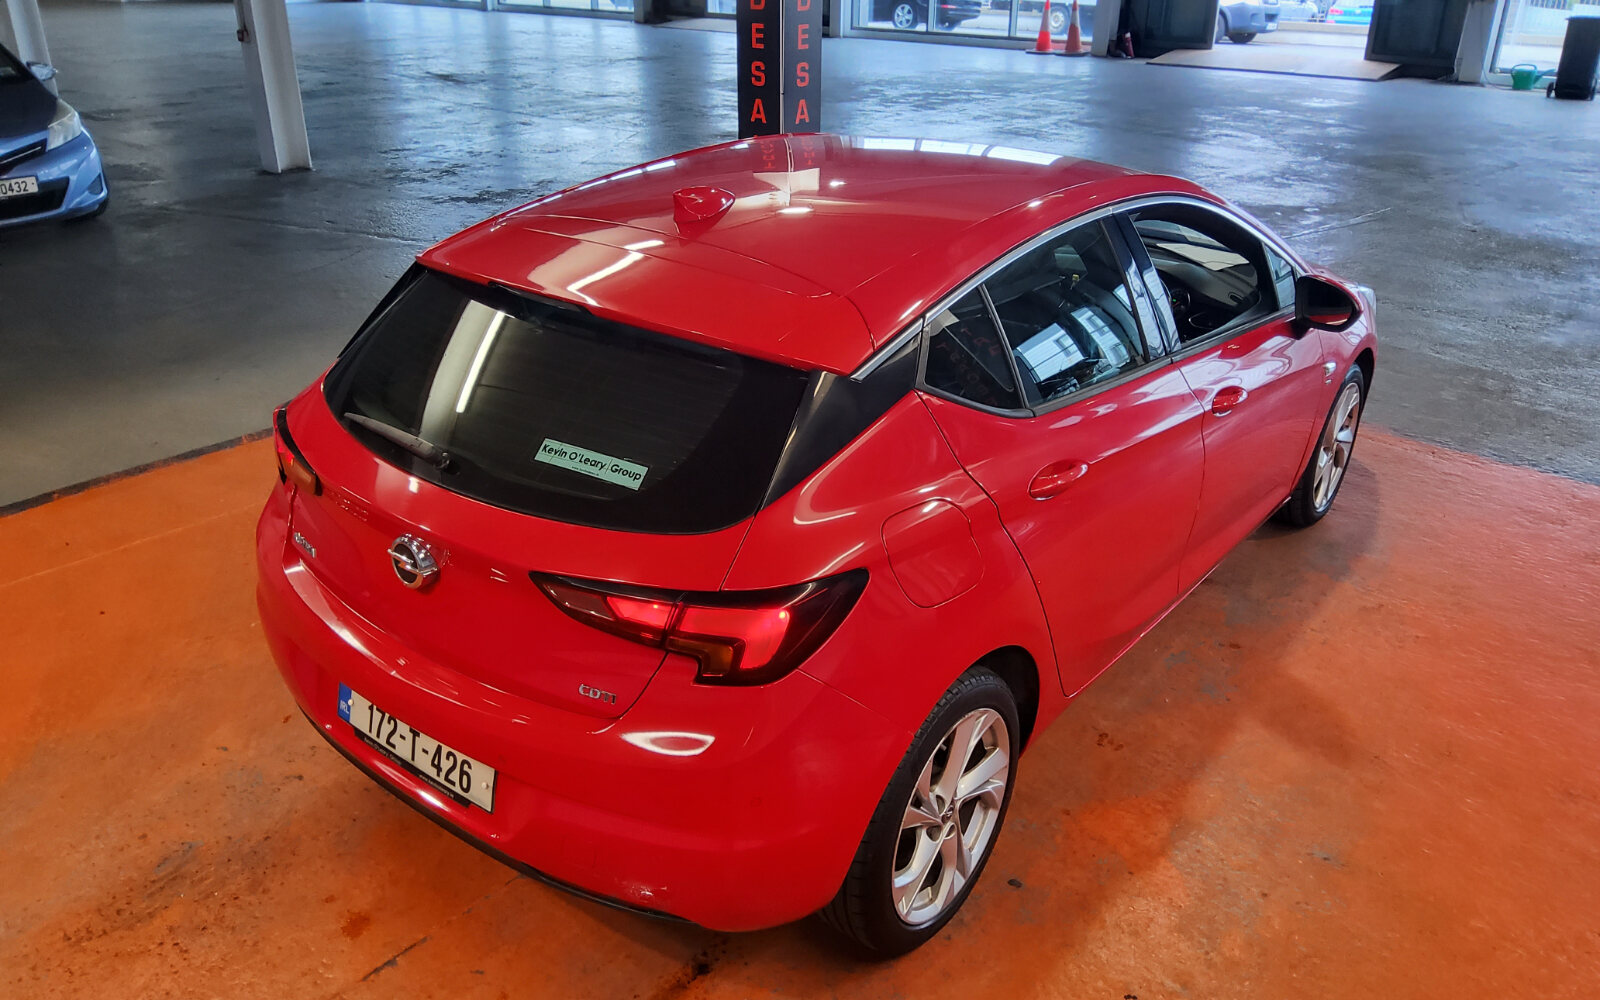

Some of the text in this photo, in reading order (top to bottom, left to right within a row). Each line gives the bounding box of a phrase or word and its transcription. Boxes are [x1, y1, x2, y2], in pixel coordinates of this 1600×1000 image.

[541, 444, 568, 458] Kevin
[568, 451, 607, 471] O'Leary
[610, 464, 642, 481] Group
[368, 703, 473, 793] 172-T-426
